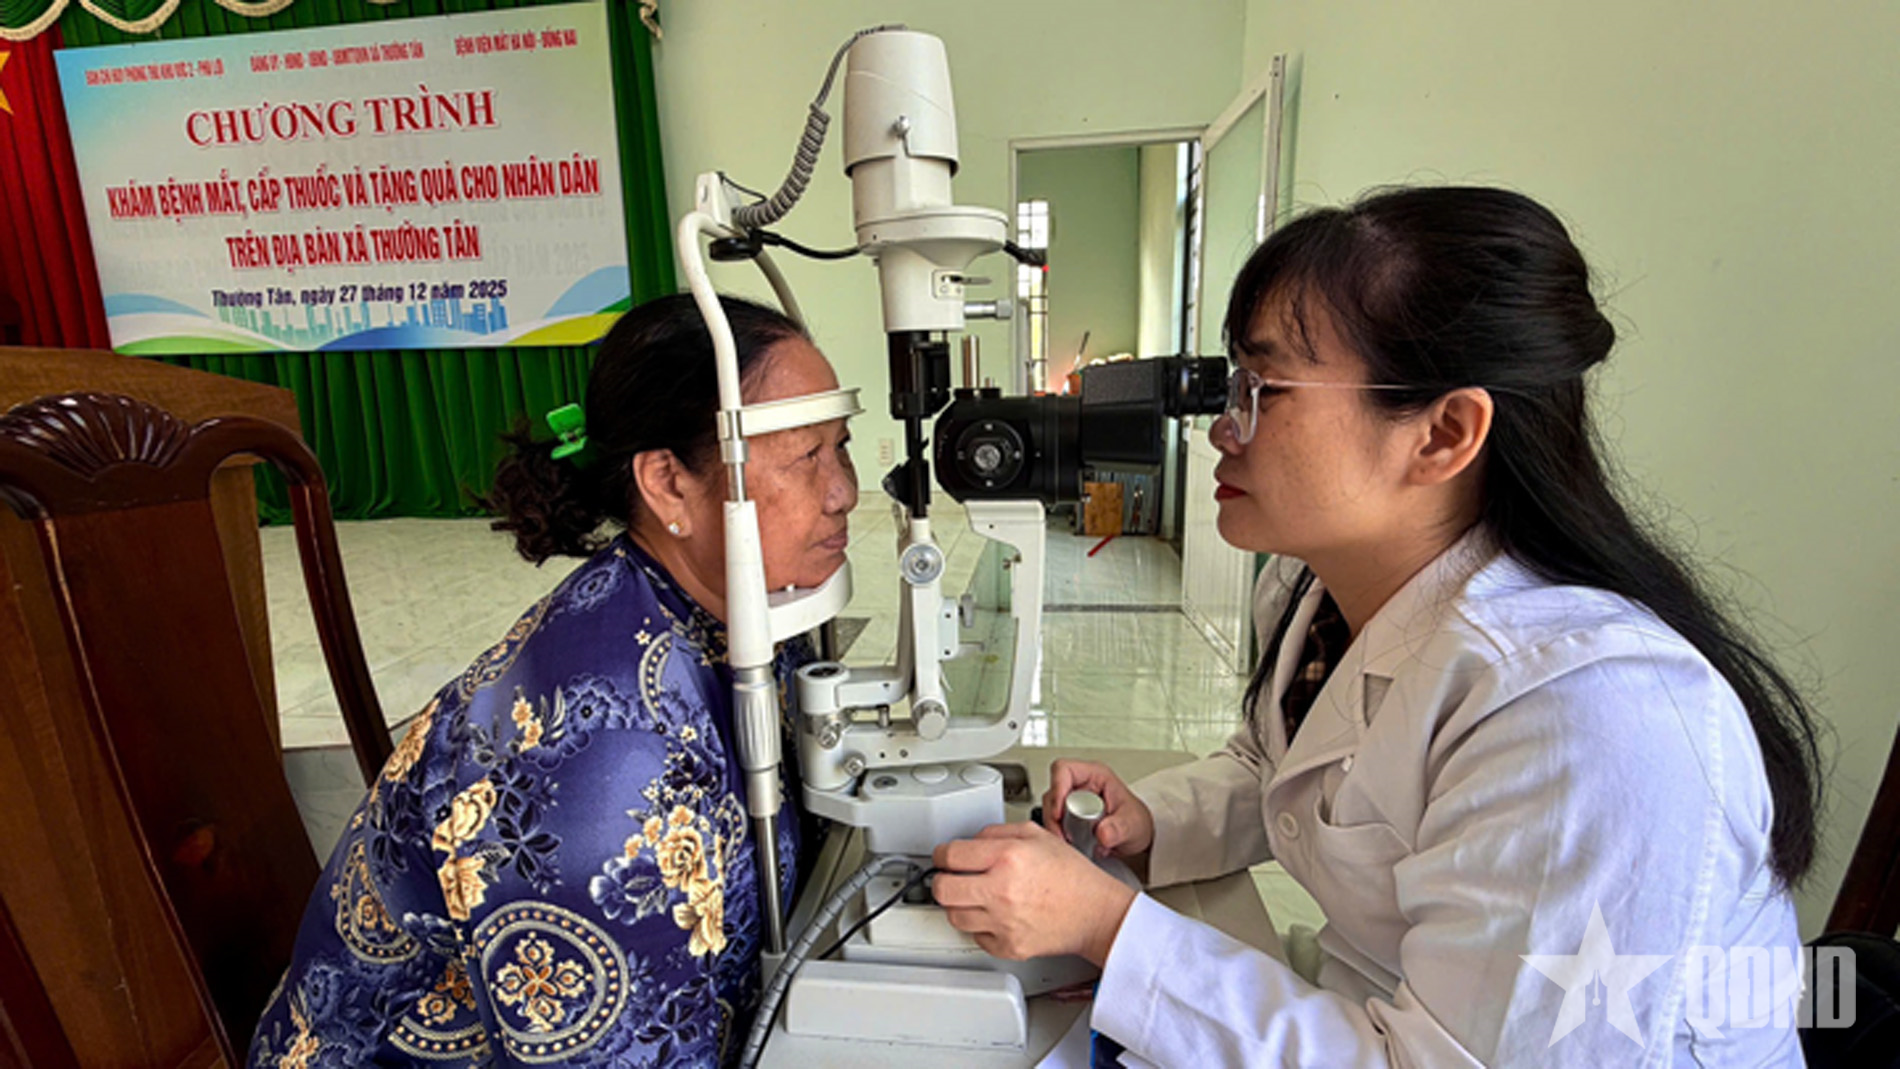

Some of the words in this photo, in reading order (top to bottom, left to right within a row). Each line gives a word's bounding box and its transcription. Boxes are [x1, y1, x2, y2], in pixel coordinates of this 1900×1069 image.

[186, 99, 356, 146] CHƯƠNG
[364, 84, 497, 134] TRÌNH
[106, 178, 157, 218] KHÁM
[157, 177, 204, 223] BỆNH
[205, 167, 247, 217] MẮT,
[247, 166, 280, 212] CẤP
[284, 163, 342, 209] THUỐC
[342, 165, 368, 206] VÀ
[369, 165, 417, 213] TẶNG
[420, 160, 457, 206] QUÀ
[460, 164, 498, 200] CHO
[502, 154, 556, 197] NHÂN
[559, 152, 600, 194] DÂN
[226, 229, 271, 268] TRÊN
[271, 233, 302, 273] ĐỊA
[304, 225, 343, 266] BÀN
[343, 223, 370, 262] XÃ
[370, 219, 439, 263] THƯỜNG
[443, 218, 481, 258] TÂN
[266, 287, 297, 306] Tân,
[300, 285, 336, 306] ngày
[339, 284, 357, 303] 27
[361, 282, 404, 303] tháng
[408, 281, 427, 300] 12
[430, 280, 465, 299] năm
[468, 279, 508, 299] 2025
